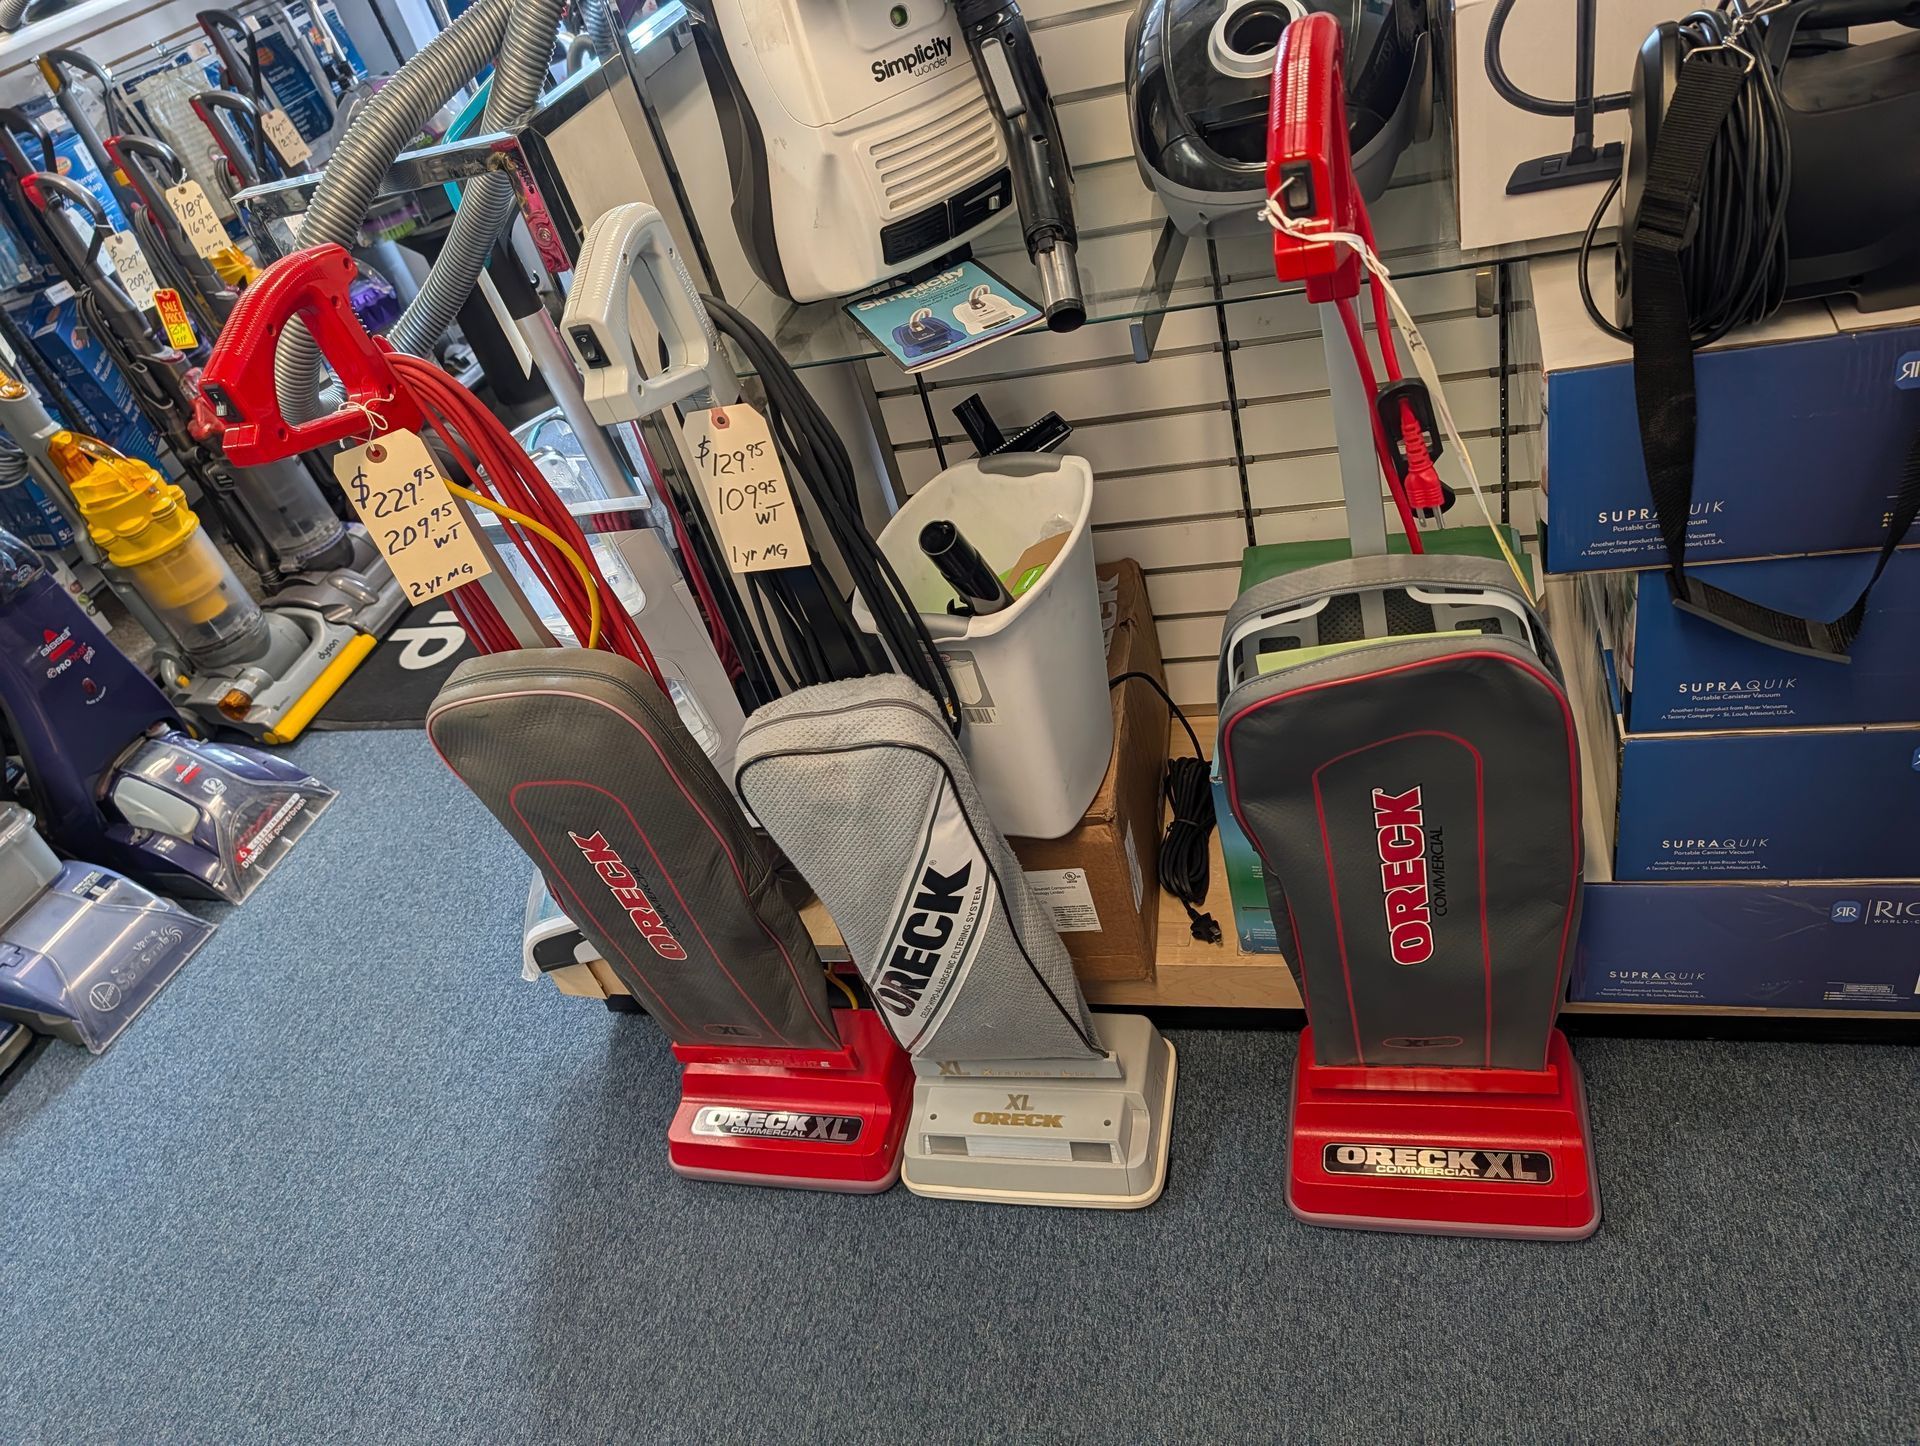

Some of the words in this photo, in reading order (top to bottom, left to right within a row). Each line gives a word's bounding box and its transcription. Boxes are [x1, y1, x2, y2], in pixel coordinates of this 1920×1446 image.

[871, 36, 951, 82] Simplicity
[914, 56, 948, 77] wonder
[856, 267, 963, 311] Simplicity
[162, 300, 179, 313] SALE
[164, 312, 184, 324] PRICE
[1612, 523, 1644, 533] Portable
[1590, 539, 1615, 548] Another
[1629, 537, 1653, 545] product
[1608, 546, 1638, 554] Company
[1704, 538, 1725, 546] U.S.A.
[733, 546, 738, 563] 1
[742, 550, 758, 567] yr
[762, 543, 788, 561] MG
[447, 563, 473, 582] MG
[319, 639, 340, 661] dyson
[274, 798, 307, 837] powerbrush
[1372, 785, 1434, 966] ORECK
[1430, 826, 1448, 917] COMMERCIAL
[568, 830, 688, 961] ORECK
[951, 923, 972, 963] FILTERING
[965, 885, 983, 924] SYSTEM
[875, 858, 973, 1018] ORECK
[720, 1025, 745, 1037] XL
[936, 1060, 971, 1076] XL
[1004, 1093, 1035, 1111] XL
[705, 1109, 812, 1131] ORECK
[808, 1116, 850, 1141] XL
[972, 1111, 1065, 1129] ORECK
[730, 1126, 806, 1138] COMMERCIAL
[1336, 1146, 1481, 1170] ORECK
[1483, 1151, 1538, 1181] XL
[1375, 1165, 1480, 1177] COMMERCIAL
